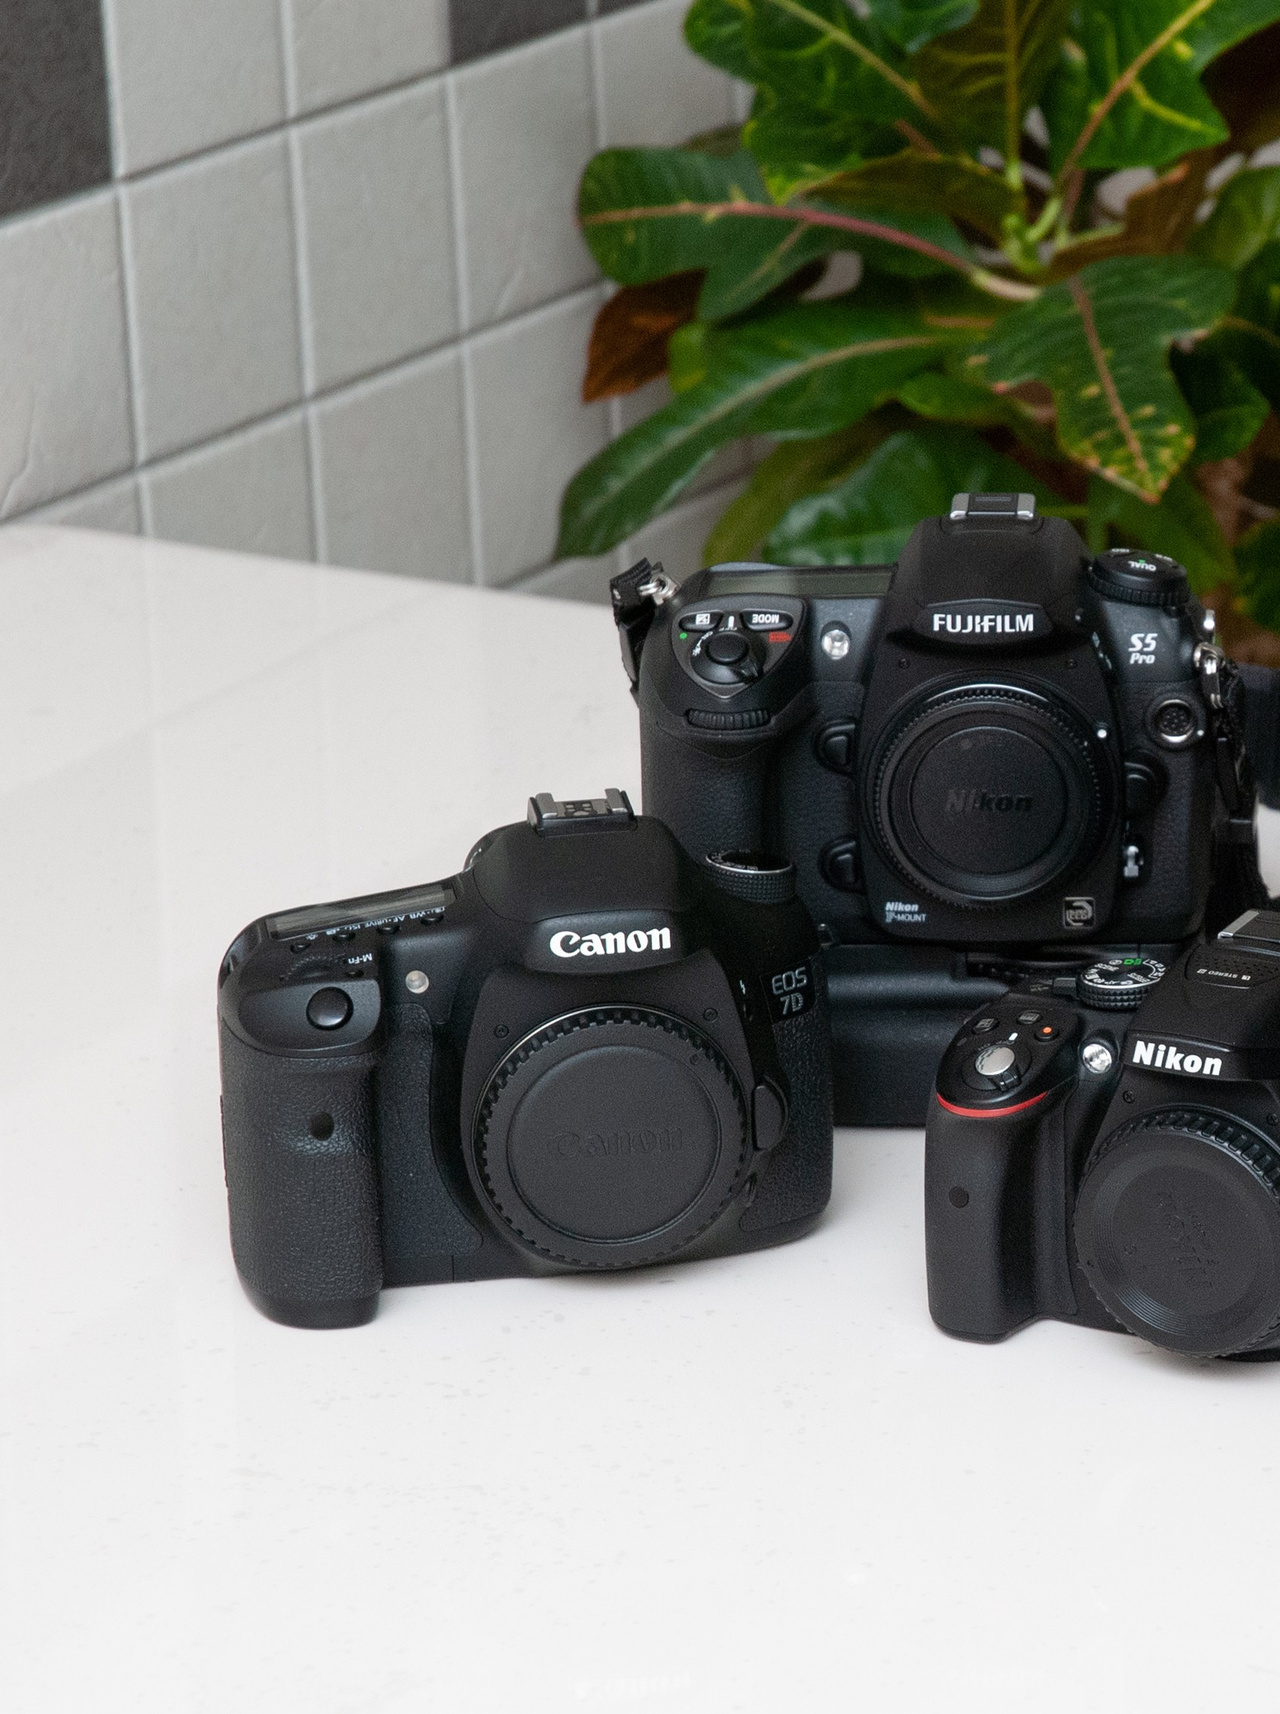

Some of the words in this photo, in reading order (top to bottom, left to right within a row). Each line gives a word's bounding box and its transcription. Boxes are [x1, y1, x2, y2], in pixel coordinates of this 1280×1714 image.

[1128, 560, 1157, 572] QUAL
[751, 613, 780, 624] MODE
[932, 613, 1034, 633] FUJIFILM
[1128, 633, 1158, 652] S5
[1129, 652, 1156, 665] Pro
[944, 789, 1035, 812] Nikon
[885, 901, 919, 912] Nikon
[549, 926, 672, 958] Canon
[347, 952, 373, 965] M-Fn
[771, 966, 808, 996] EOS
[779, 992, 804, 1015] 7D
[1132, 1039, 1223, 1076] Nikon
